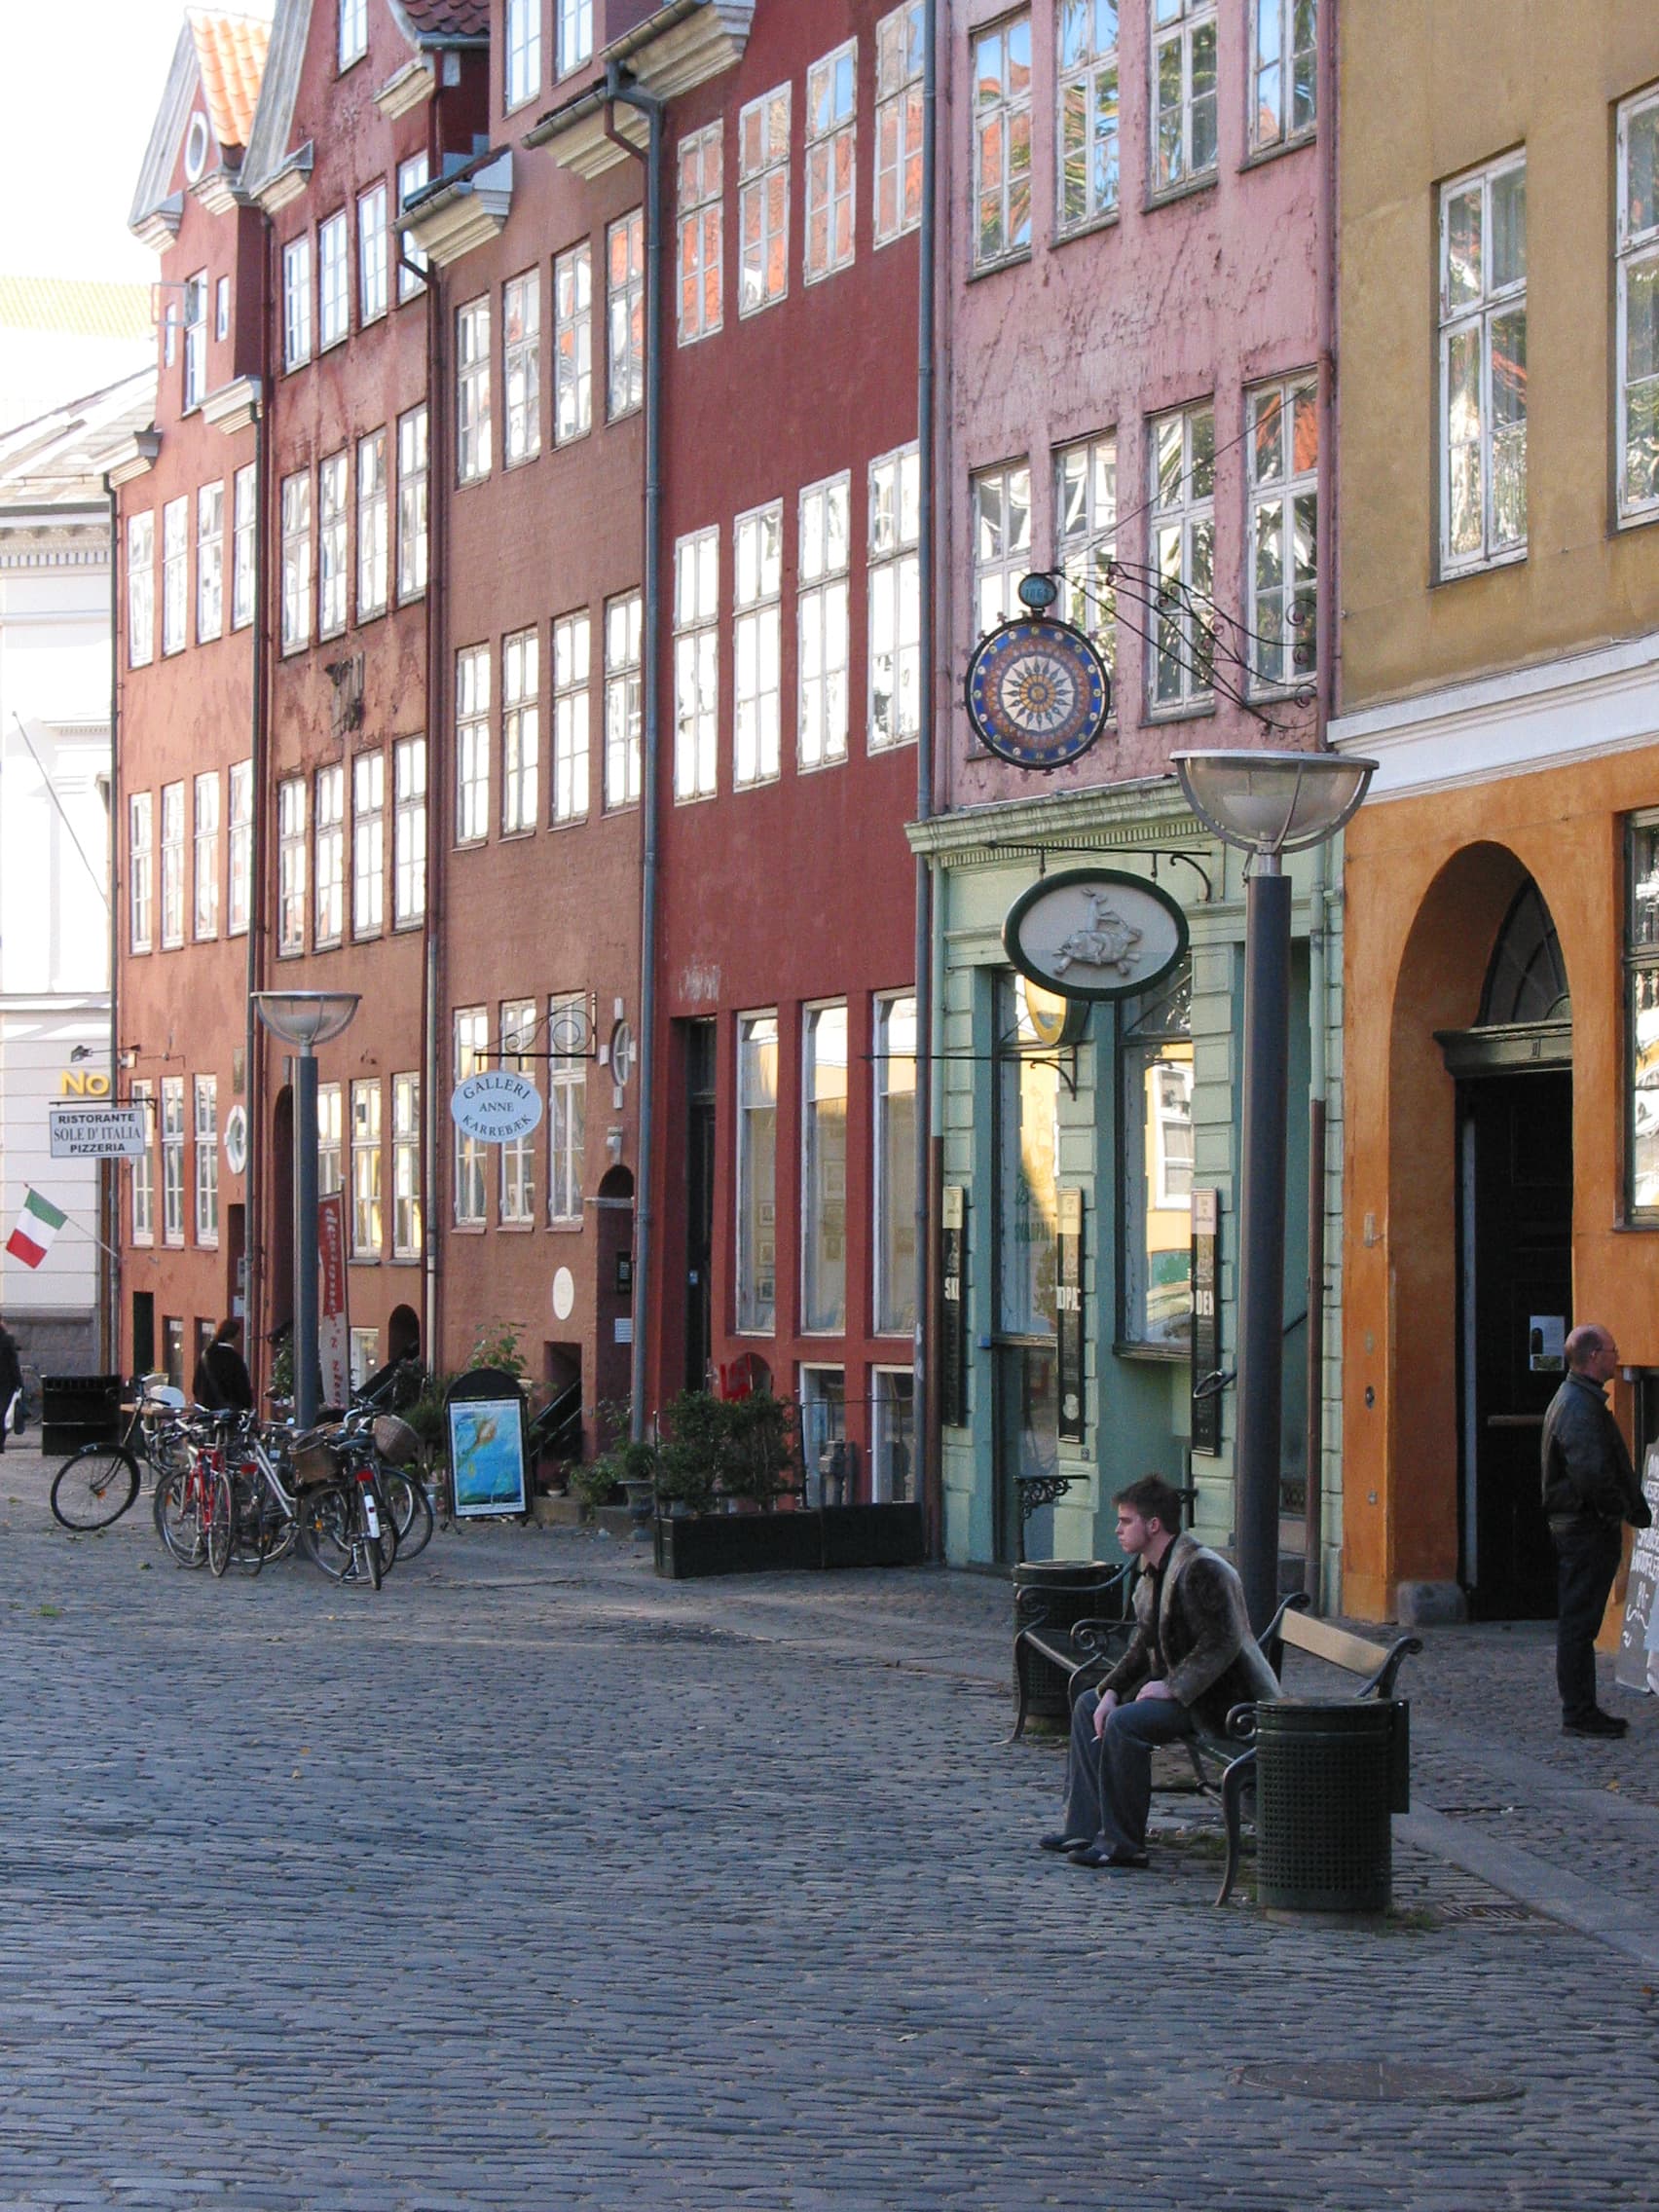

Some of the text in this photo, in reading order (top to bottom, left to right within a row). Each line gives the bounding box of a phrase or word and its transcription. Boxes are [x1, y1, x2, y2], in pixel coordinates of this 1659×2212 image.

[463, 1078, 530, 1099] GALLERI
[479, 1101, 514, 1113] ANNE
[58, 1114, 135, 1124] RISTORANTE
[462, 1114, 533, 1135] KARREBÆK
[54, 1127, 85, 1141] SOLE
[101, 1125, 141, 1140] ITALIA
[70, 1143, 125, 1153] PIZZERIA
